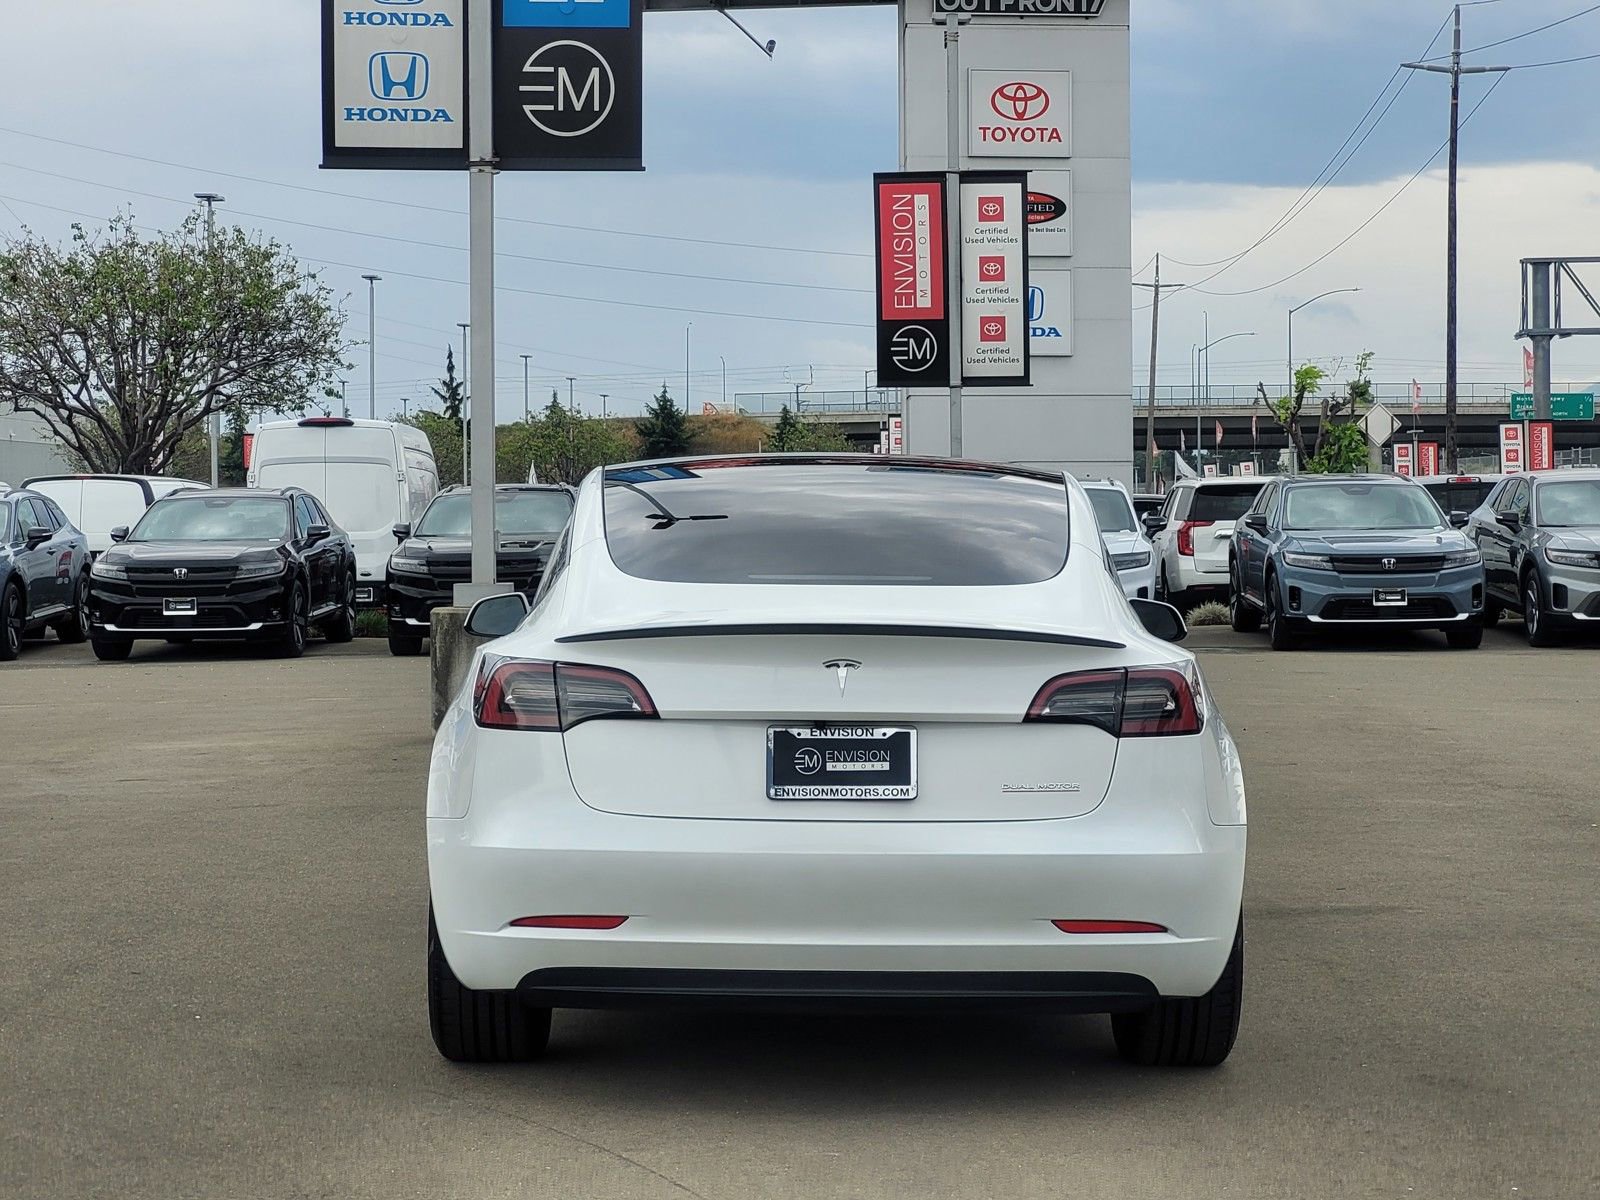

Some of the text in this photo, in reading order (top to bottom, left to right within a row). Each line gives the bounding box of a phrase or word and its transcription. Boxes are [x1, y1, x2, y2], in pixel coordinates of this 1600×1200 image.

[343, 12, 454, 27] HONDA
[344, 107, 454, 122] HONDA
[978, 126, 1062, 143] TOYOTA
[974, 227, 1009, 235] Certified
[987, 236, 1018, 244] Vehicles
[892, 194, 915, 309] ENVISION
[918, 203, 928, 298] MOTORS
[975, 287, 1010, 295] Certified
[988, 296, 1019, 304] Vehicles
[976, 347, 1010, 355] Certified
[988, 356, 1020, 364] Vehicles
[1533, 427, 1542, 469] ENVISION
[810, 727, 874, 737] ENVISION
[826, 750, 890, 762] ENVISION
[1037, 782, 1080, 790] MOTOR
[774, 787, 910, 797] ENVISIONMOTORS.COM
